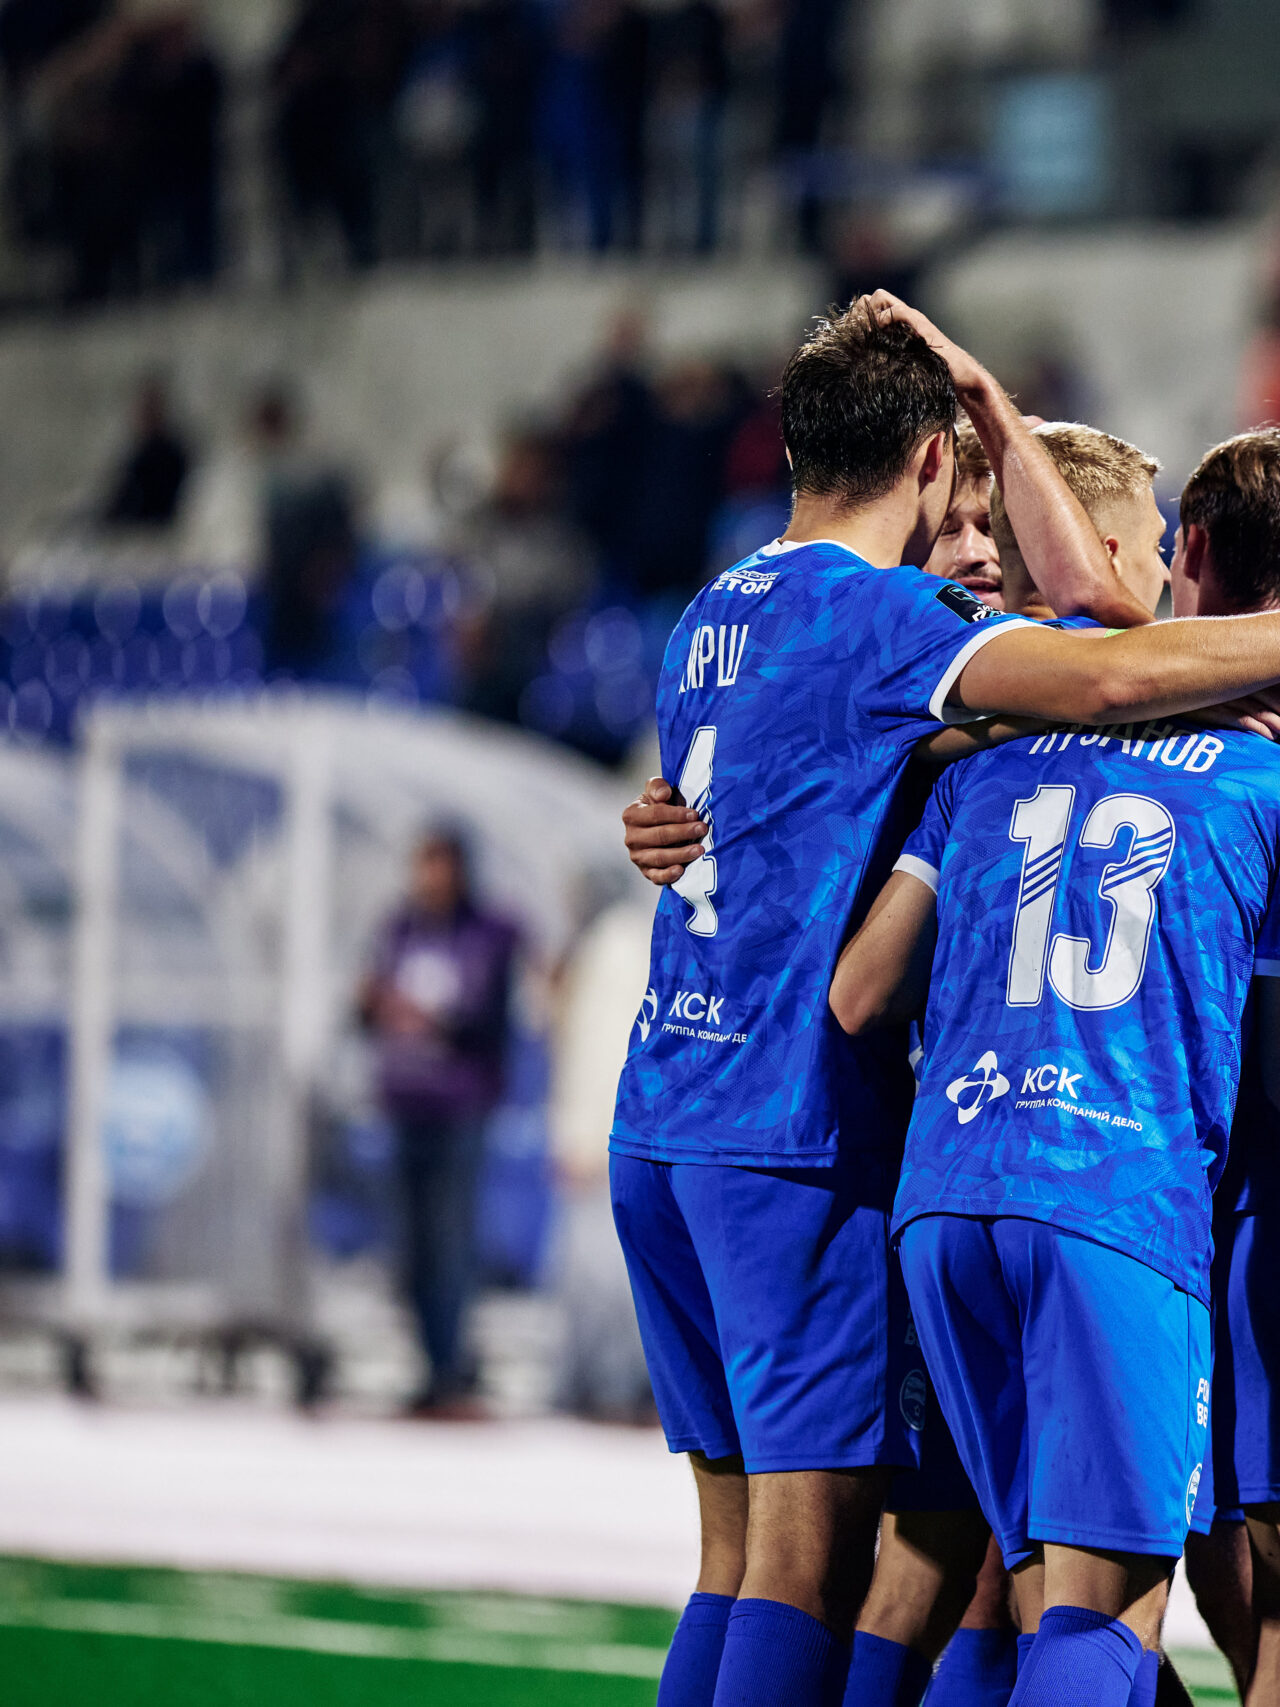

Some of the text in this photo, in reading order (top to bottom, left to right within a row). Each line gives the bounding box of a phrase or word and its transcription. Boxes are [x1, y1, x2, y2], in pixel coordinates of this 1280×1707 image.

[1006, 784, 1176, 1012] 13
[669, 990, 725, 1026] КСК
[661, 1022, 696, 1038] ГРУППА
[1021, 1064, 1083, 1100] КСК
[1015, 1097, 1143, 1132] ГРУППА КОМПАНИЙ ДЕЛО
